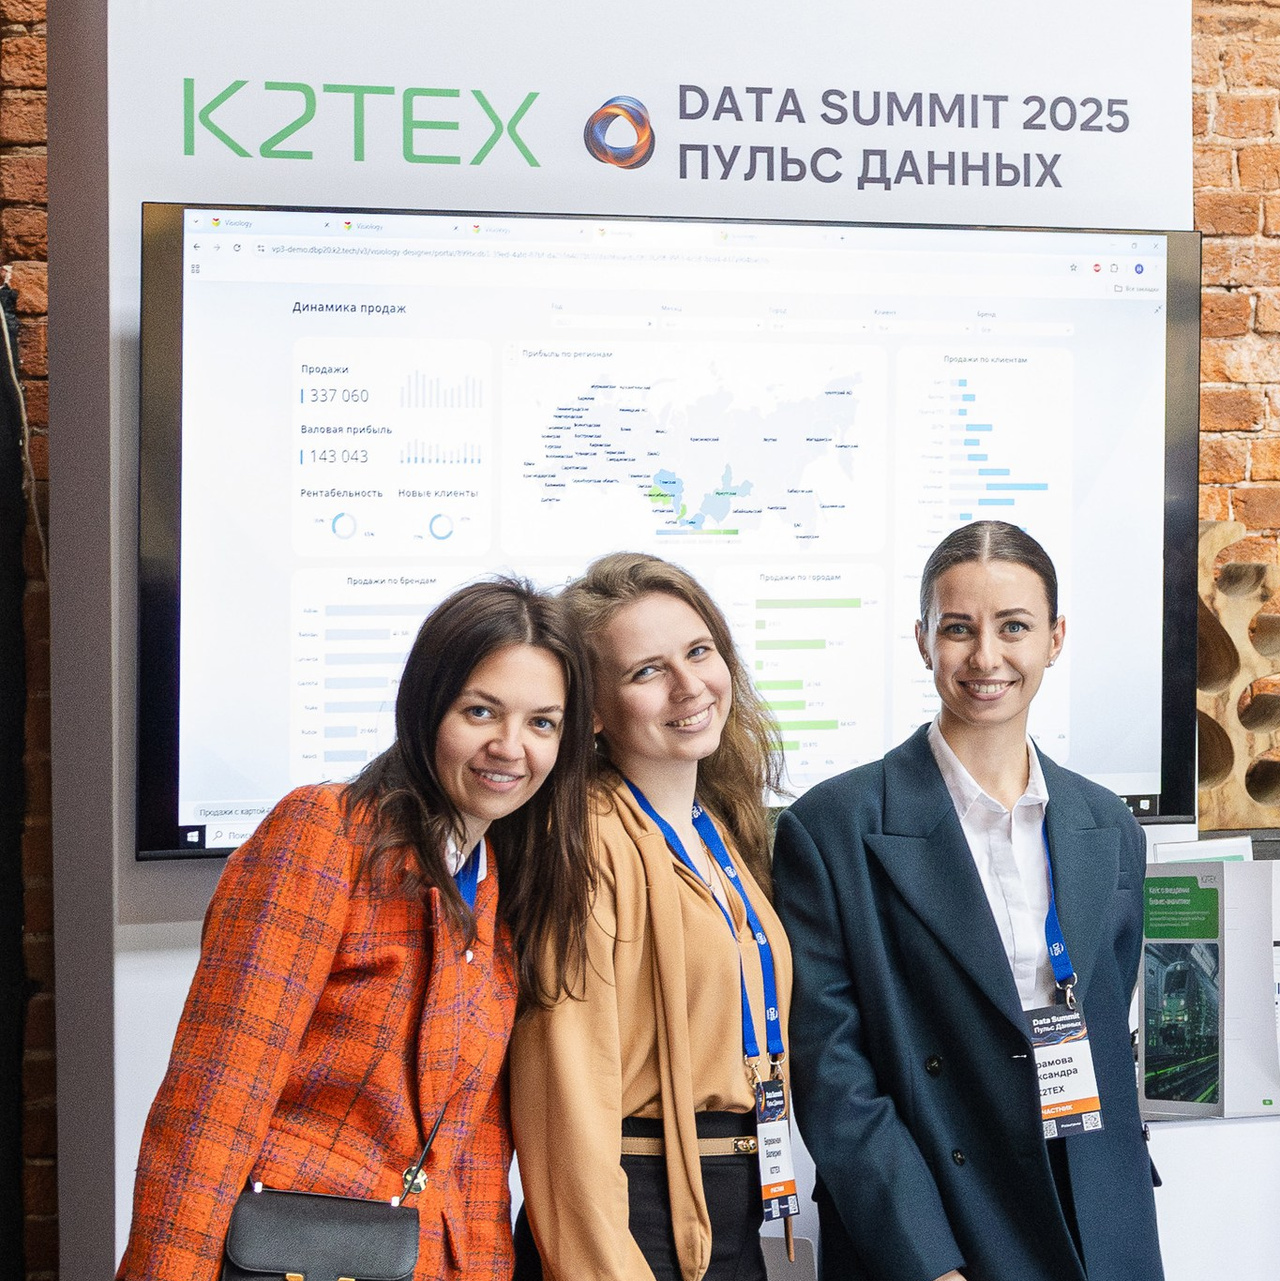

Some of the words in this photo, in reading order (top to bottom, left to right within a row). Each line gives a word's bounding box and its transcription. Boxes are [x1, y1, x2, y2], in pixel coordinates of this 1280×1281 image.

[679, 83, 806, 124] DATA
[820, 88, 1009, 130] SUMMIT
[1022, 94, 1130, 134] 2025
[182, 77, 542, 168] K2TEX
[679, 142, 843, 184] ПУЛЬС
[857, 148, 1063, 191] ДАННЫХ
[292, 301, 357, 314] Динамика
[360, 303, 407, 316] продаж
[943, 355, 978, 365] Продажи
[301, 364, 349, 375] Продажи
[310, 388, 337, 403] 337
[341, 388, 370, 403] 060
[301, 425, 344, 435] Валовая
[346, 425, 393, 436] прибыль
[310, 449, 337, 464] 143
[341, 449, 369, 464] 043
[300, 488, 384, 499] Рентабельность
[398, 488, 431, 498] Новые
[347, 576, 386, 587] Продажи
[400, 576, 437, 585] брендам
[199, 808, 233, 818] Продажи
[241, 807, 265, 817] картой
[1032, 1017, 1051, 1027] Data
[1051, 1012, 1081, 1023] Summit
[1033, 1025, 1055, 1035] Пульс
[1055, 1020, 1082, 1031] Данных
